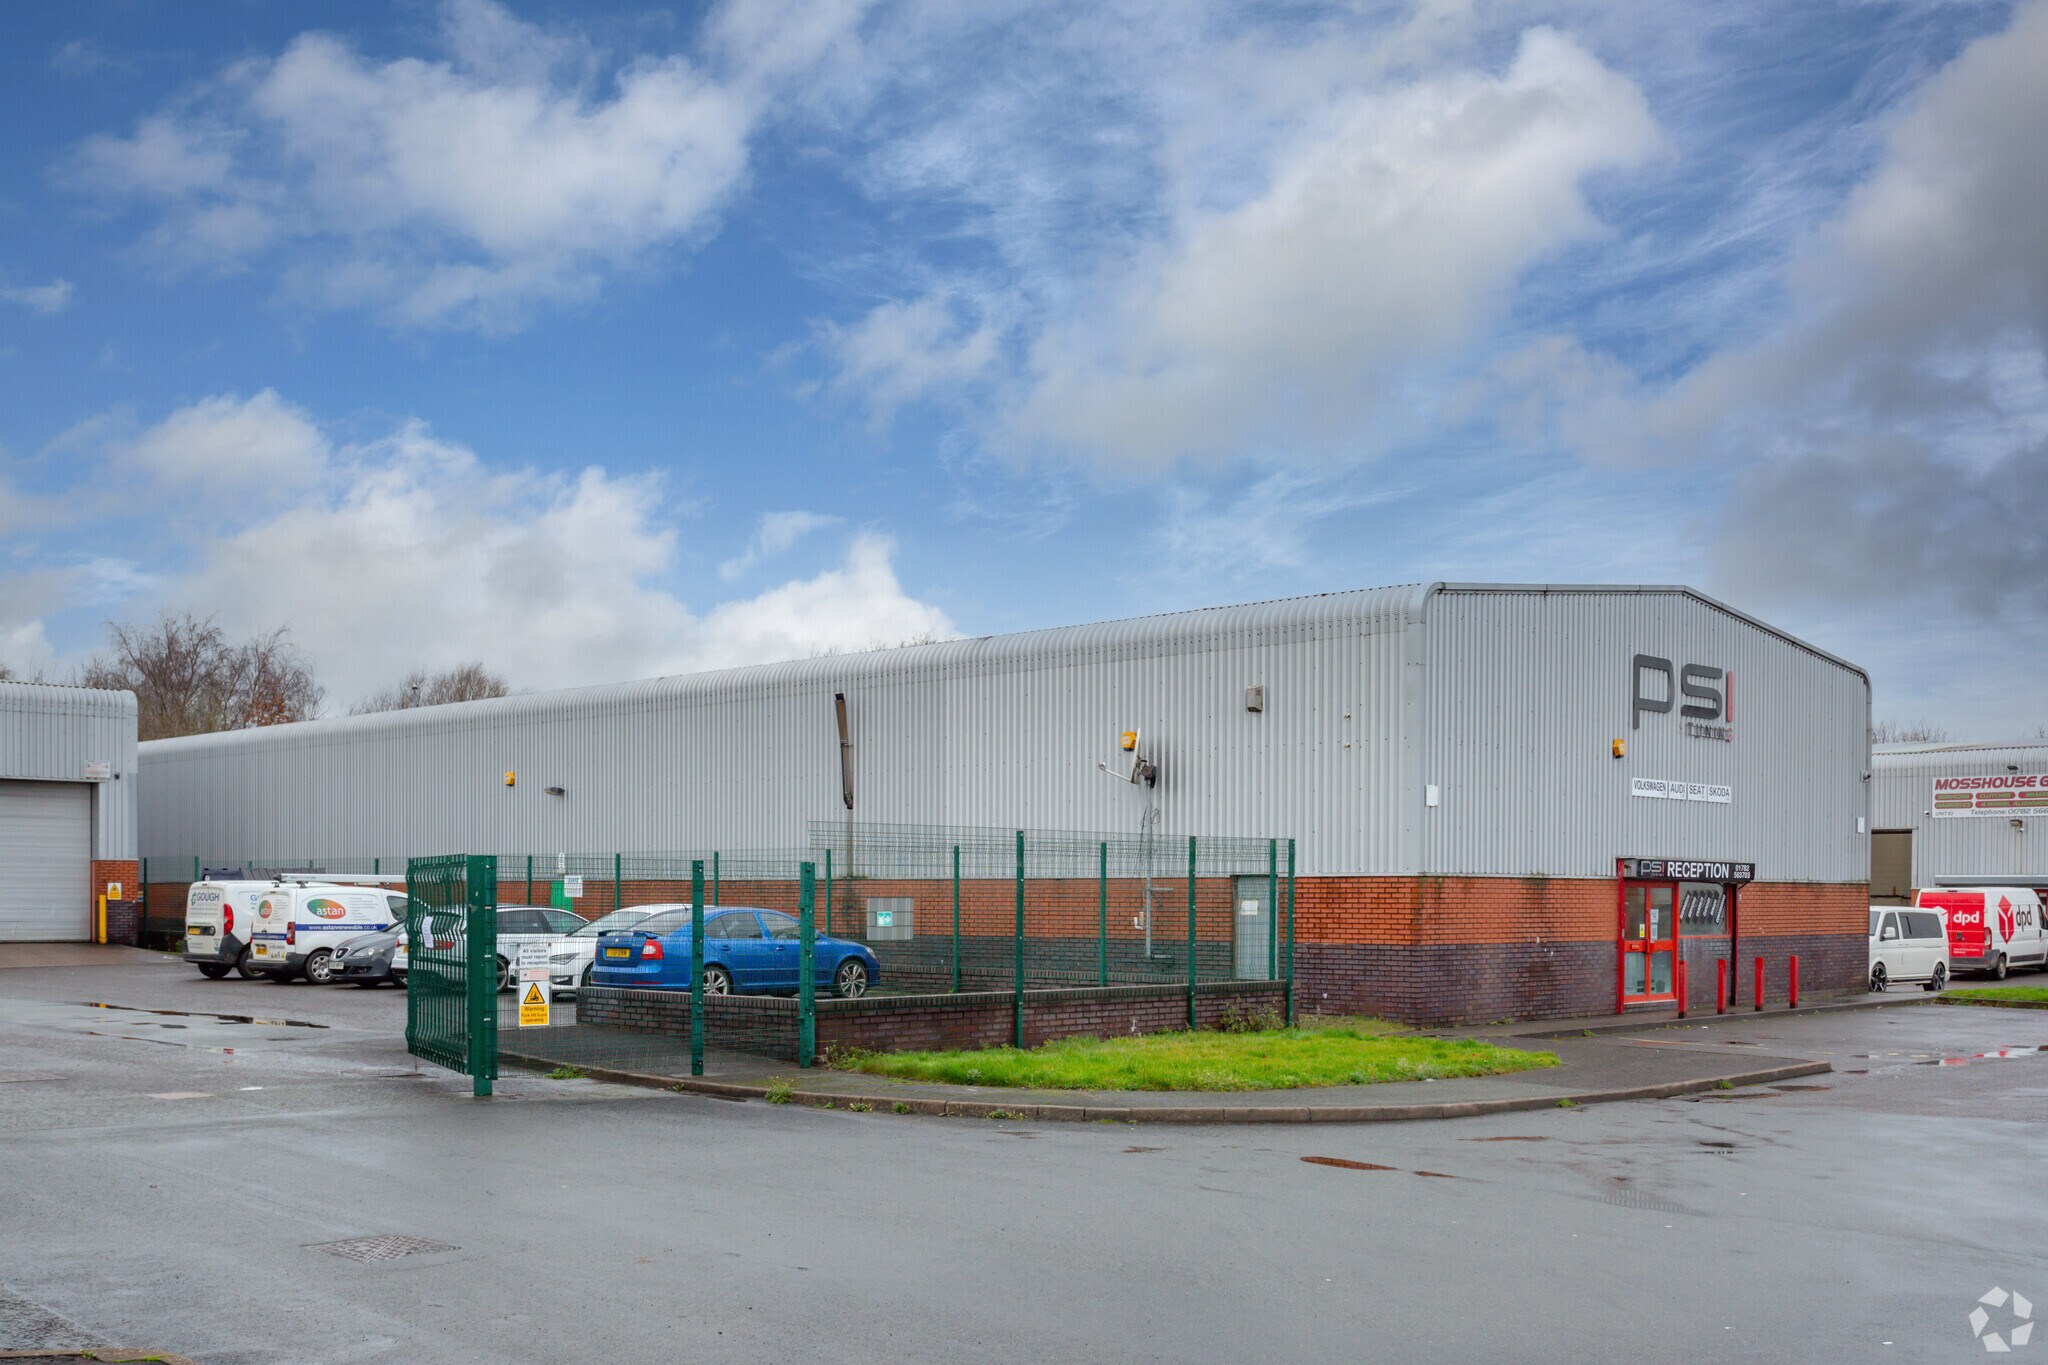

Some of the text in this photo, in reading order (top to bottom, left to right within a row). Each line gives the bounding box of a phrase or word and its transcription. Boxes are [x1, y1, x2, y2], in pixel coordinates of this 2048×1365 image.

[1634, 780, 1666, 792] VOLKSWAGEN
[1935, 776, 2037, 790] MOSSHOUSE
[1670, 784, 1686, 794] AUDI
[1689, 785, 1705, 795] SEAT
[1709, 787, 1730, 797] SKODA
[1667, 861, 1729, 879] RECEPTION
[1735, 864, 1750, 872] 01782
[196, 892, 220, 902] GOUGH
[316, 907, 345, 916] astan
[1953, 911, 1980, 926] dpd
[2016, 904, 2032, 932] dpd
